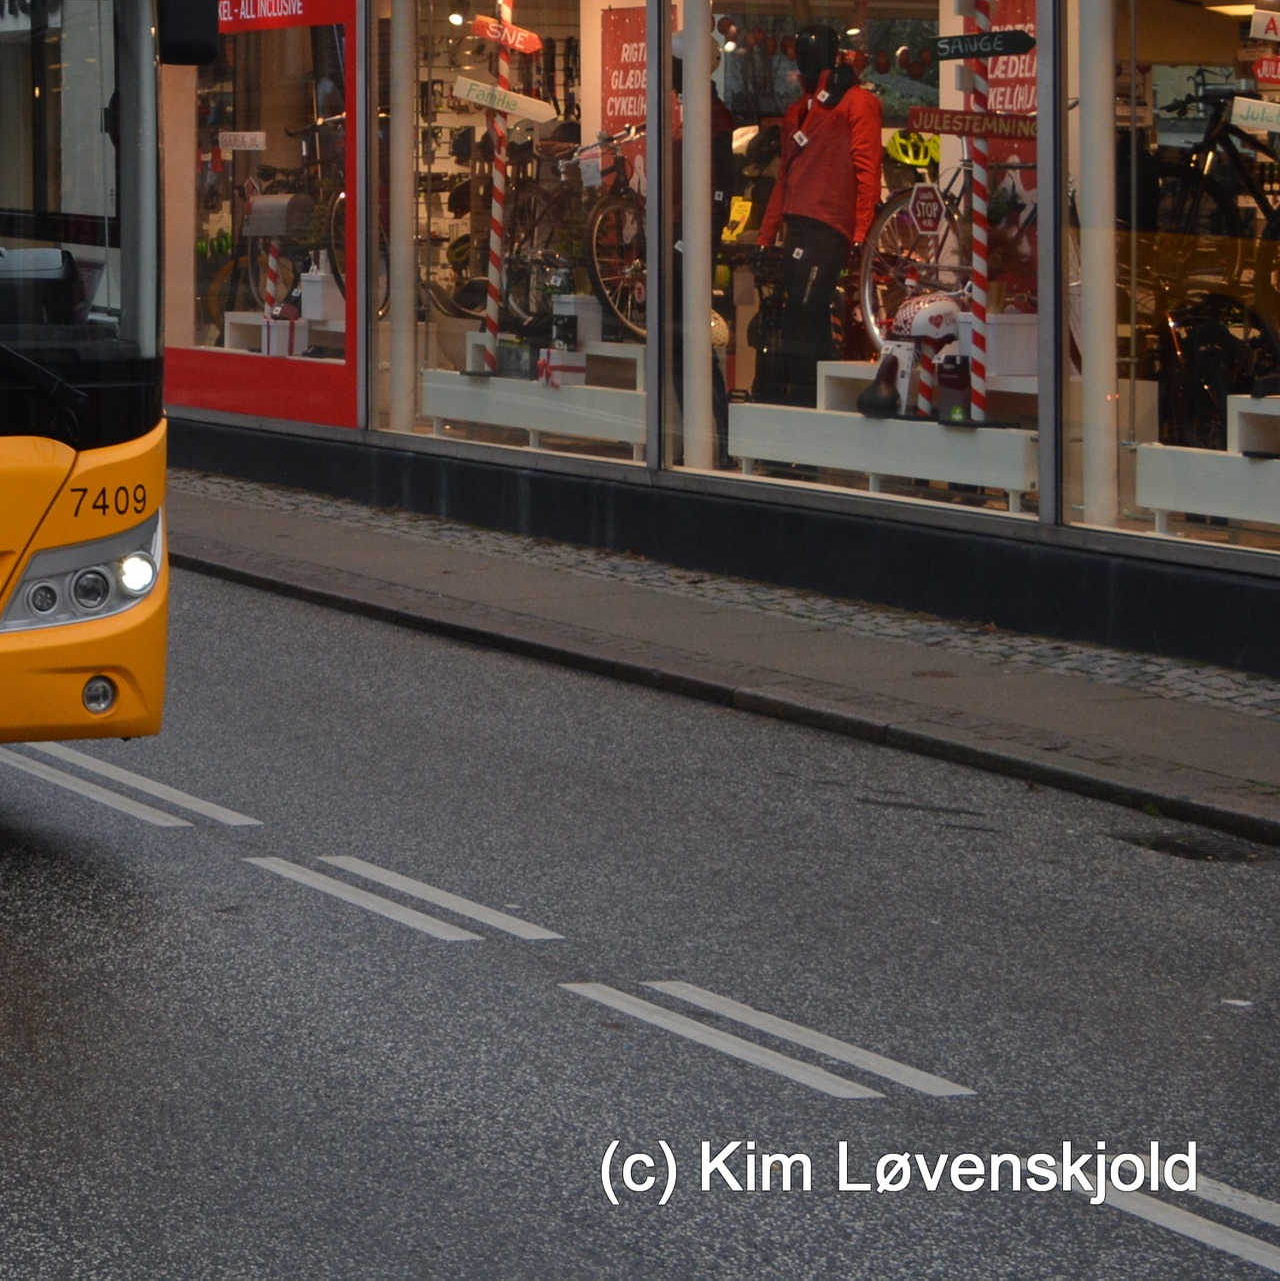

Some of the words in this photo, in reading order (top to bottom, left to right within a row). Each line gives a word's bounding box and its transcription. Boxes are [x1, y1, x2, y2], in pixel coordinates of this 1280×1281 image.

[486, 23, 529, 49] SNE
[937, 34, 1004, 56] SANGE
[467, 83, 518, 112] Familie
[916, 201, 938, 218] STOP
[70, 483, 147, 518] 7409
